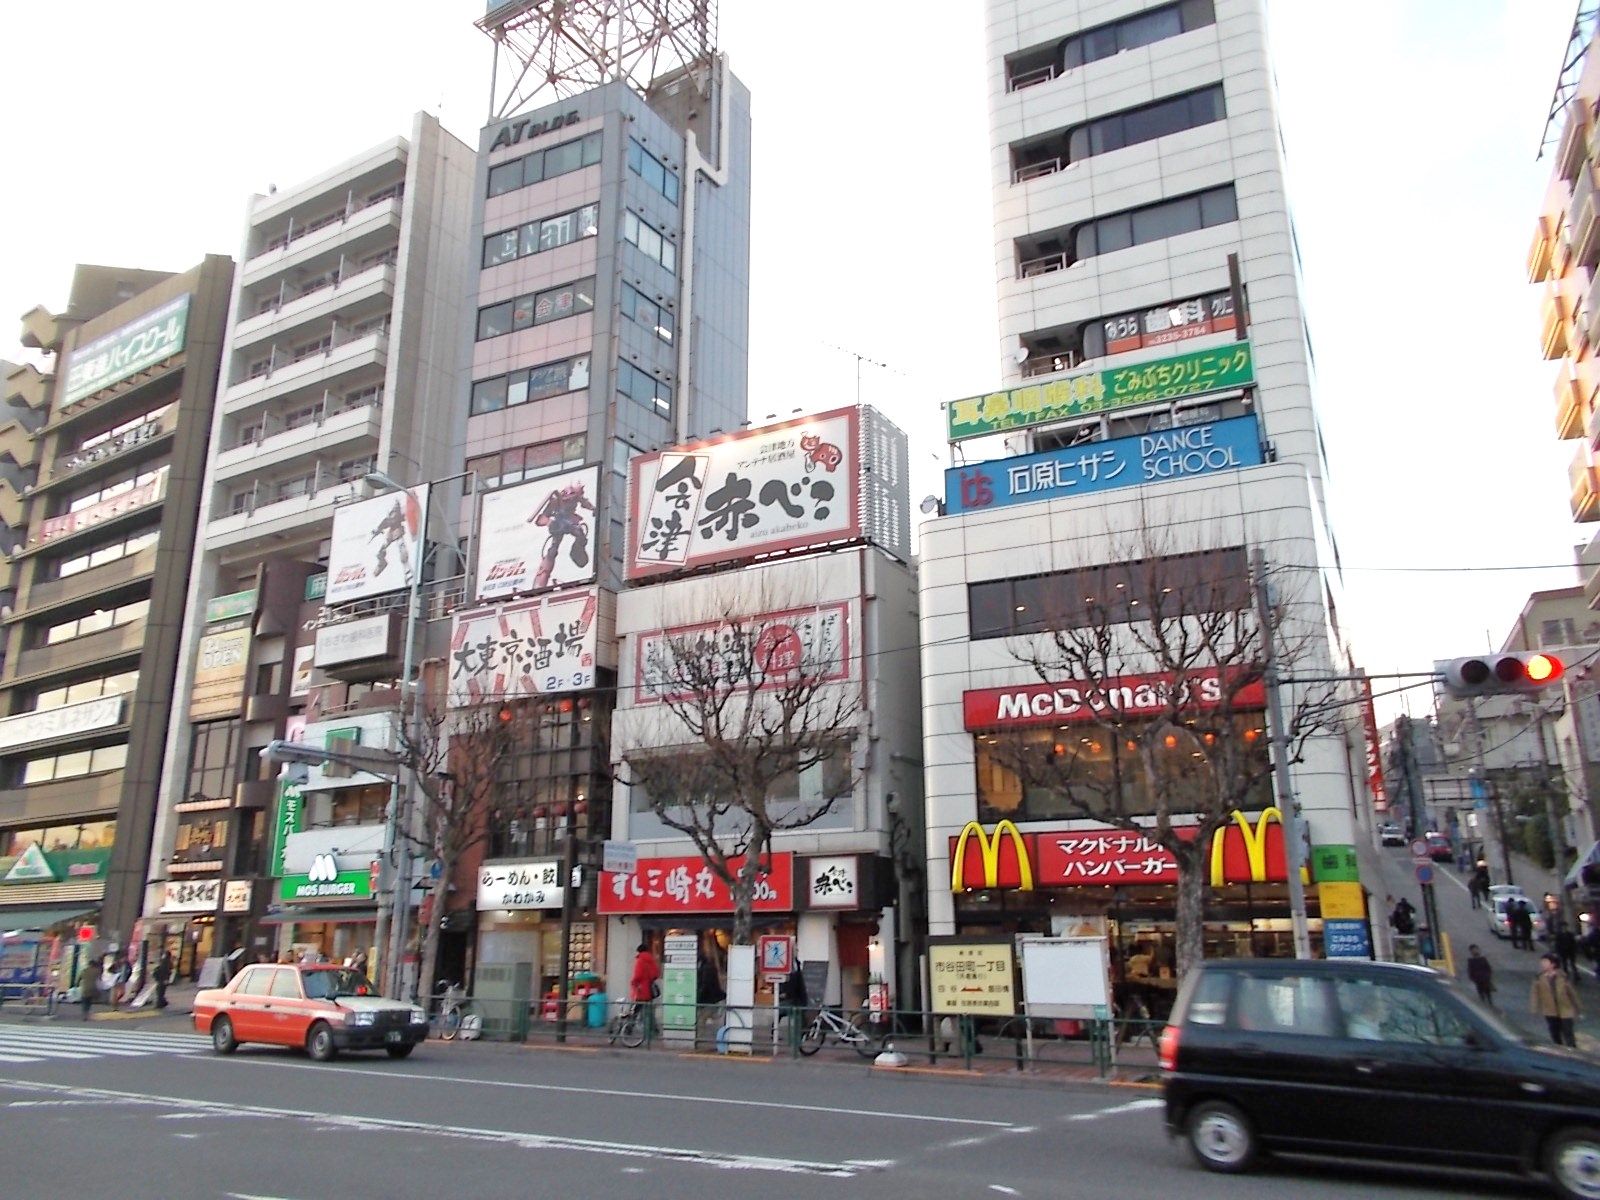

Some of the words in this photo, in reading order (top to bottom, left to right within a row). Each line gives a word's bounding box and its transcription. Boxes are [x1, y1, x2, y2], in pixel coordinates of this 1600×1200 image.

[490, 119, 530, 152] AT
[1210, 296, 1235, 317] クリニ
[1140, 426, 1214, 459] DANCE
[1007, 451, 1127, 496] 石原ヒサシ
[1142, 447, 1241, 480] SCHOOL
[698, 472, 835, 541] 赤べこ
[452, 619, 585, 680] 大東京酒場
[1057, 836, 1167, 856] マクドナル
[1063, 857, 1179, 877] ハンバーガー
[296, 884, 318, 897] MOS
[318, 882, 356, 896] BURGER
[611, 865, 716, 905] すし三崎丸
